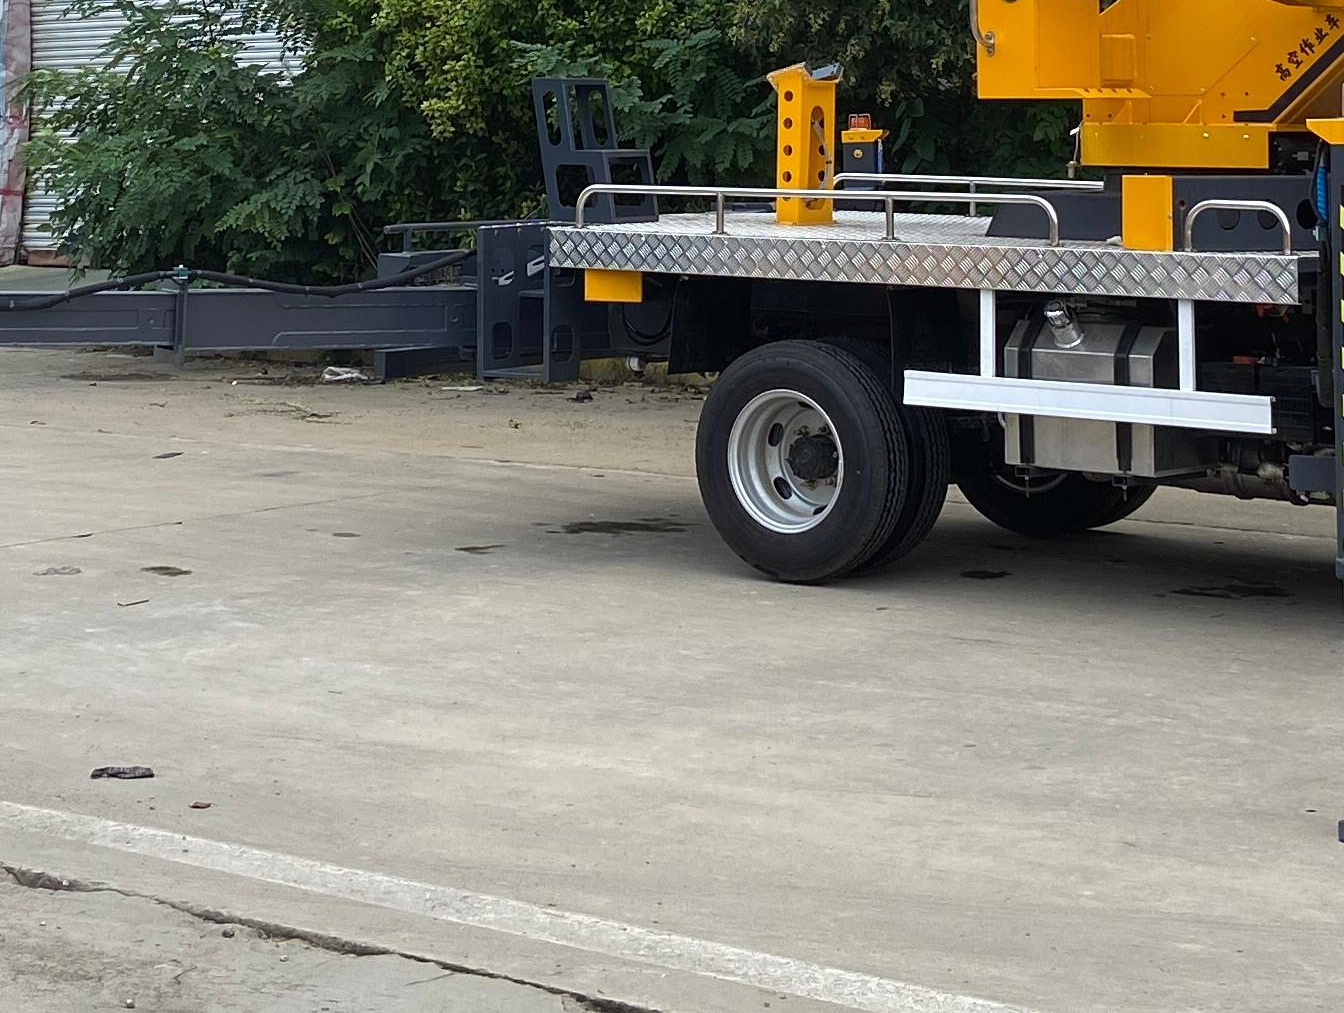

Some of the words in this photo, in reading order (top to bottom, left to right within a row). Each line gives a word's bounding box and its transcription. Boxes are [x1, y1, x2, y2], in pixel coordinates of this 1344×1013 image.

[1274, 13, 1341, 82] 高空作业车
